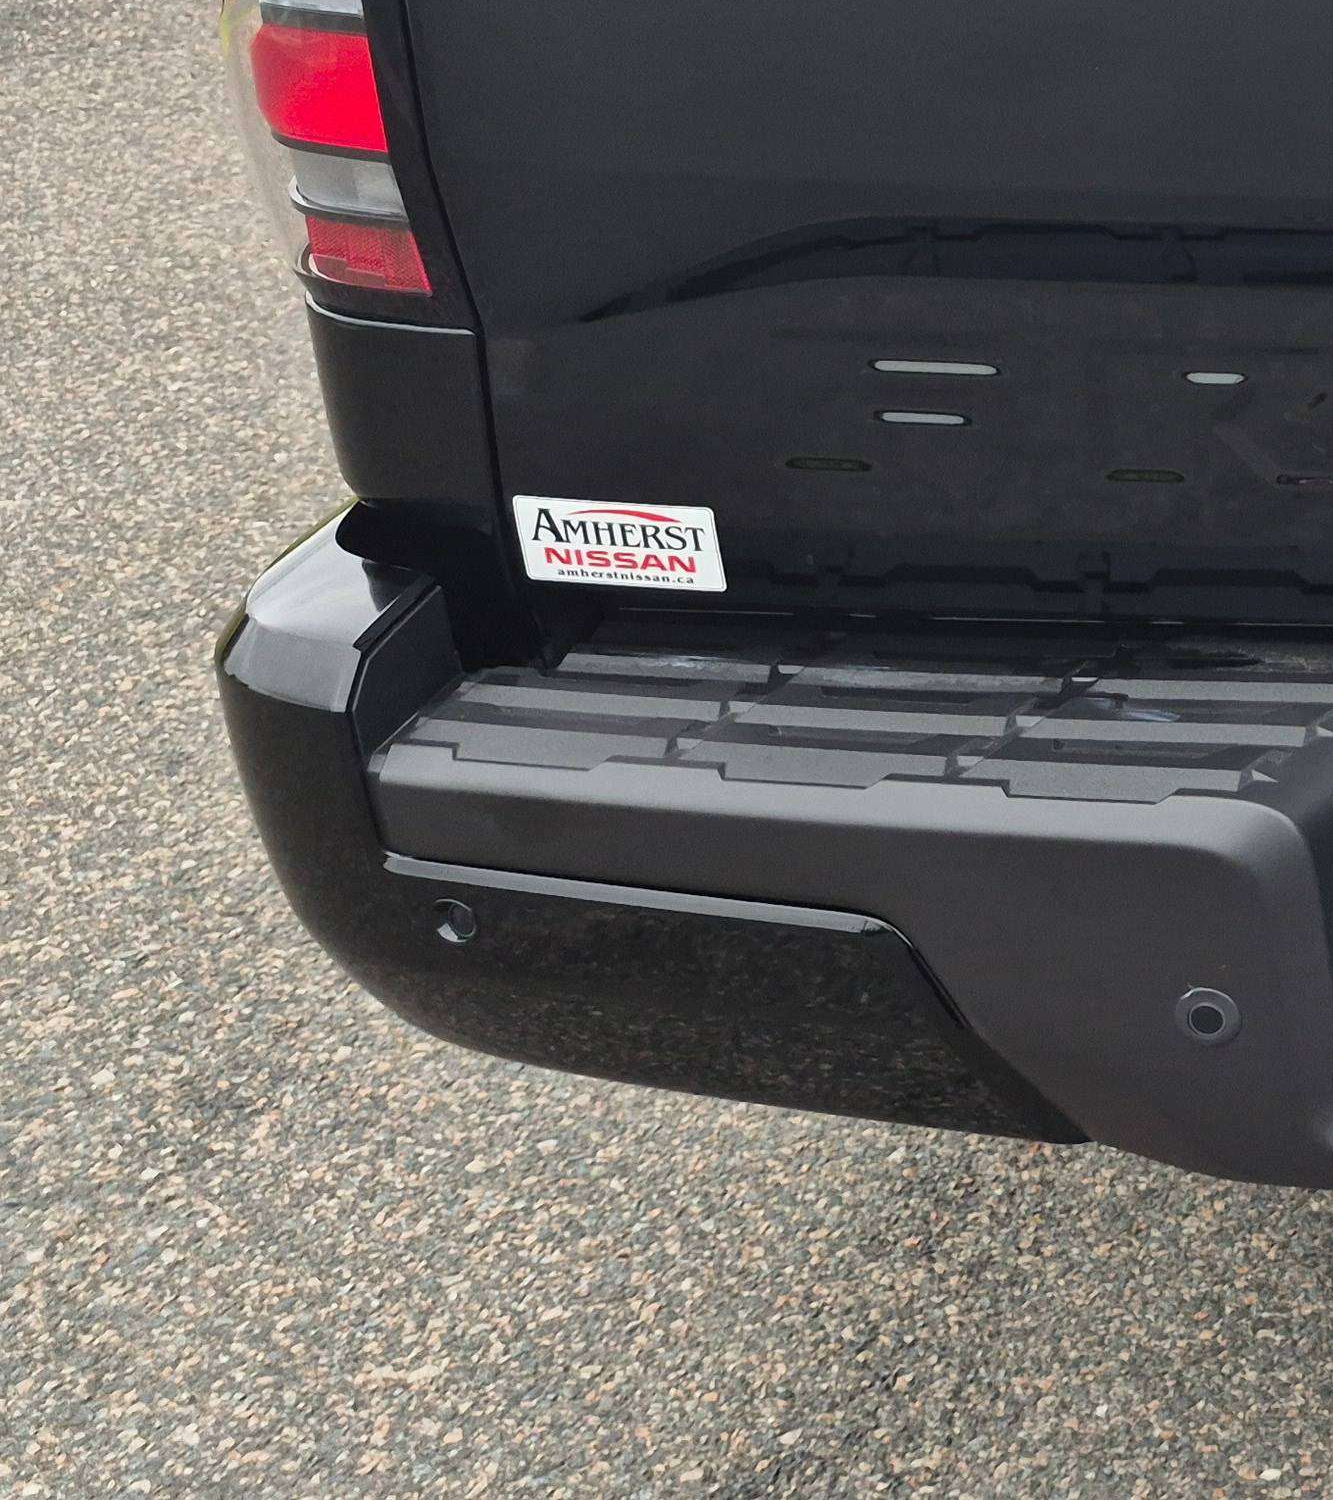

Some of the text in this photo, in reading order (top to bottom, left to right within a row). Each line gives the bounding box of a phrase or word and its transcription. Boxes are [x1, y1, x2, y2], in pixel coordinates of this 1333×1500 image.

[532, 508, 706, 552] AMHERST
[544, 547, 697, 573] NISSAN
[558, 569, 695, 585] amherstnissan.ca
